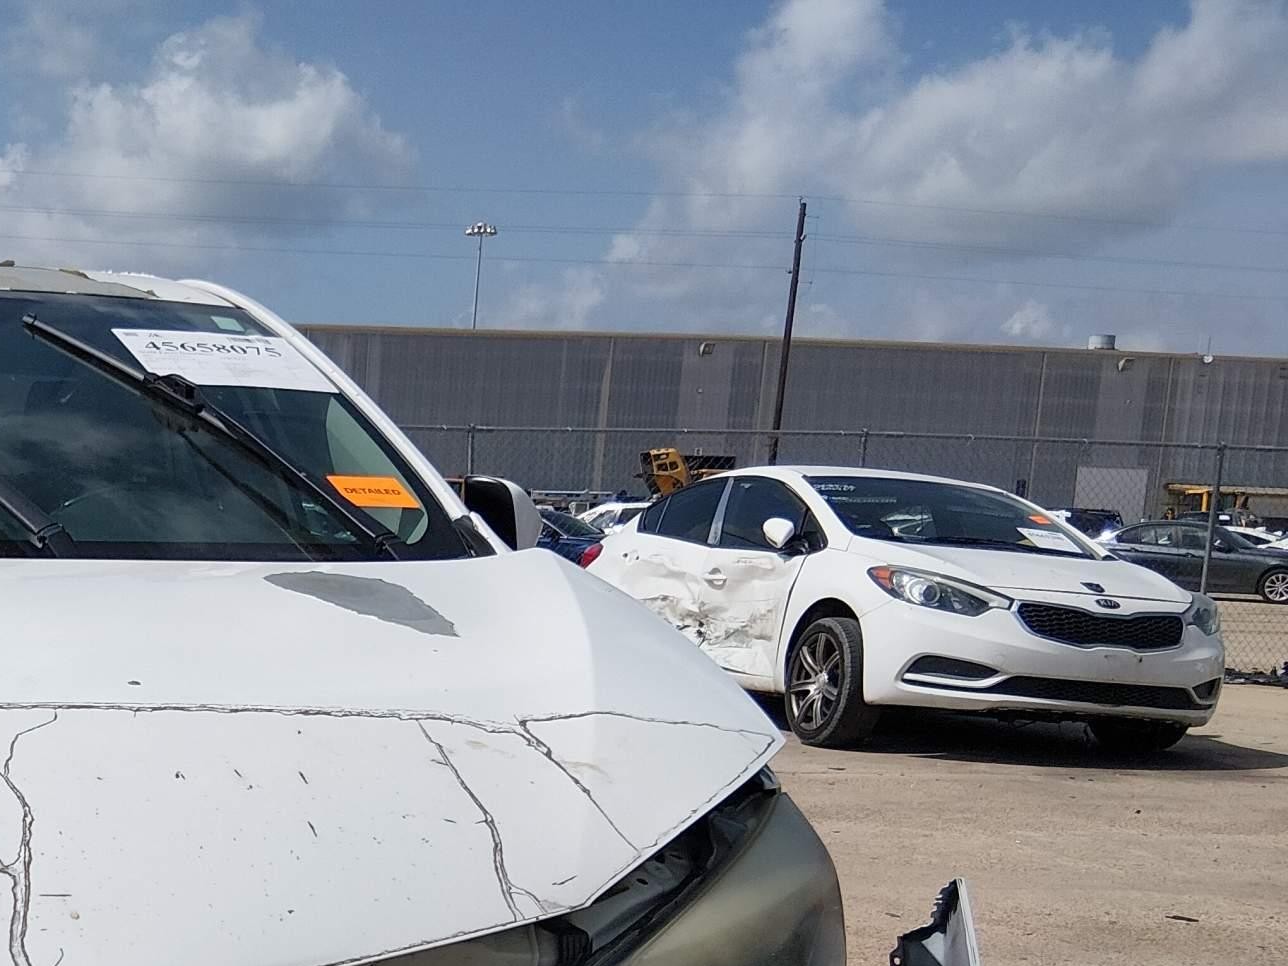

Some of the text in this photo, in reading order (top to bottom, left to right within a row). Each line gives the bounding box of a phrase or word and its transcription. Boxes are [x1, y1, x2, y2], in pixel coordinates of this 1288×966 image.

[144, 340, 282, 358] 45658075
[343, 487, 401, 496] DETAILED
[1097, 599, 1119, 609] KIA
